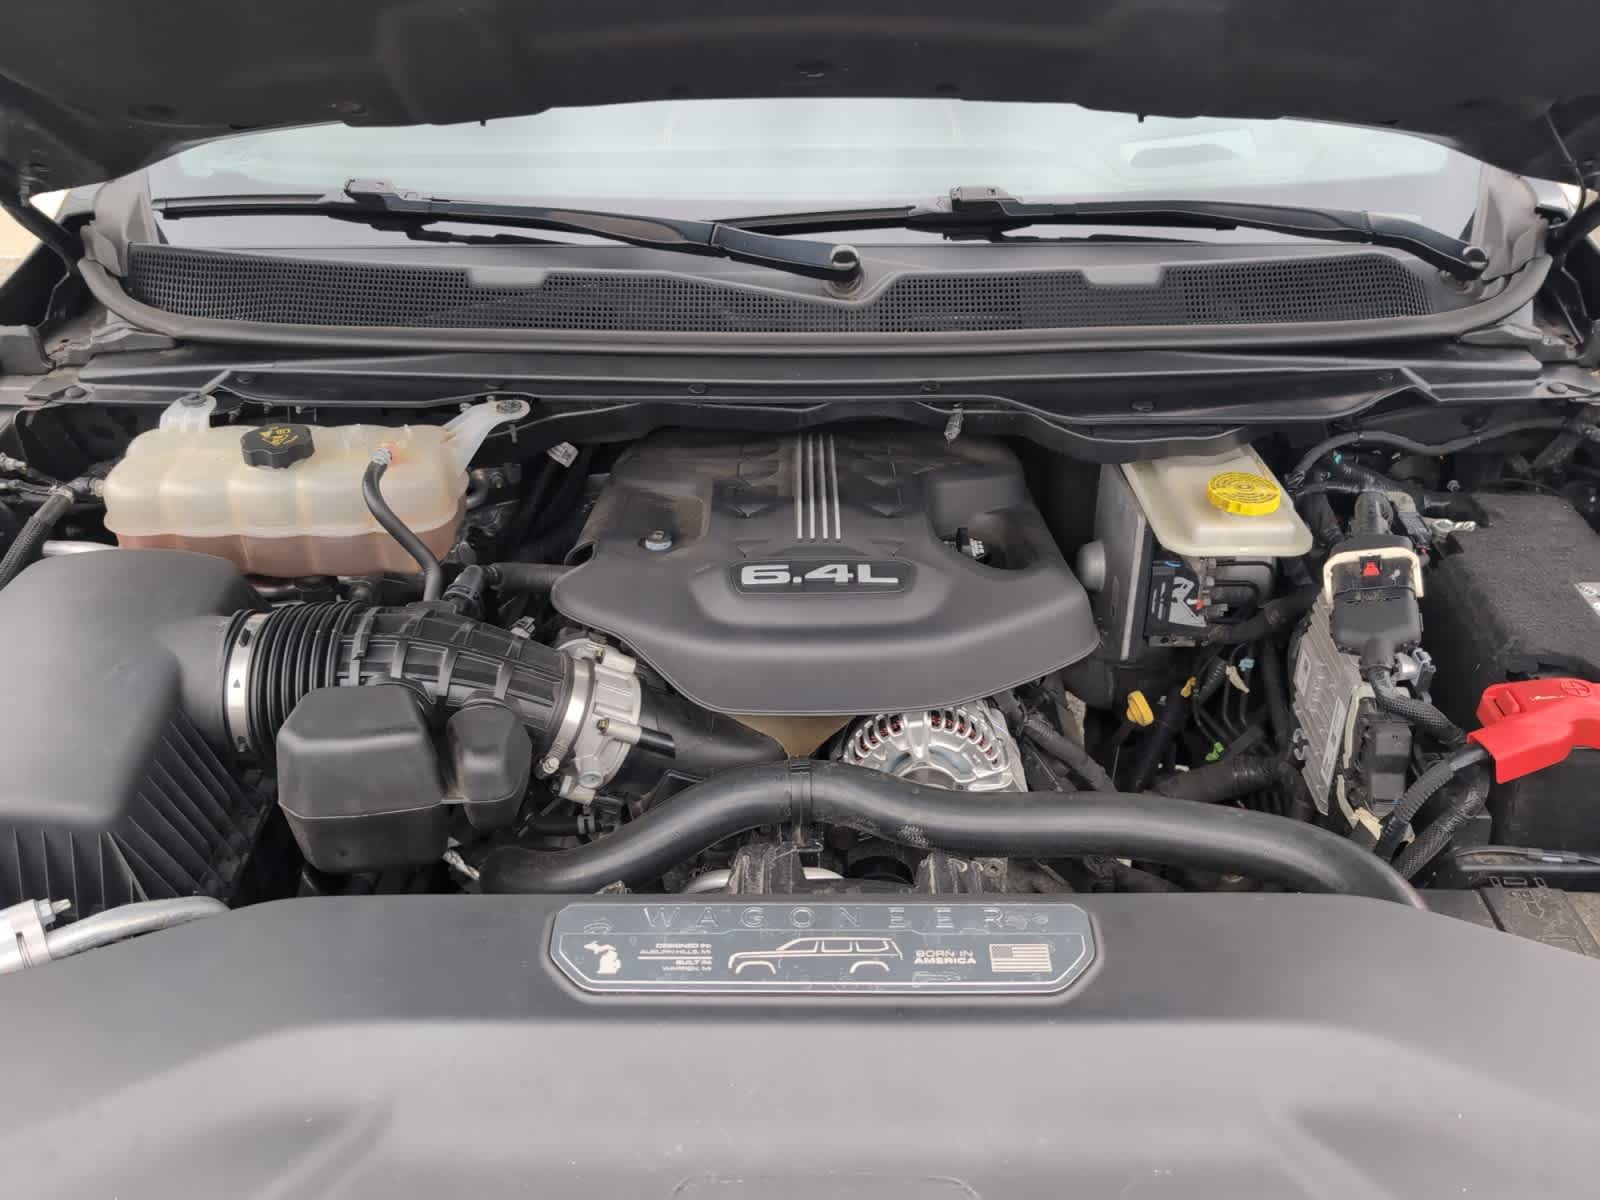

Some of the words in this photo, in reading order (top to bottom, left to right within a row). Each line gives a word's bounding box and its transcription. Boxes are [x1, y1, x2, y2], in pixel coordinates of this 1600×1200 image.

[741, 564, 899, 585] 6.4L
[643, 906, 1004, 929] WAGONEER
[914, 957, 977, 965] AMERICA
[915, 949, 955, 958] BORN
[959, 949, 974, 958] IN
